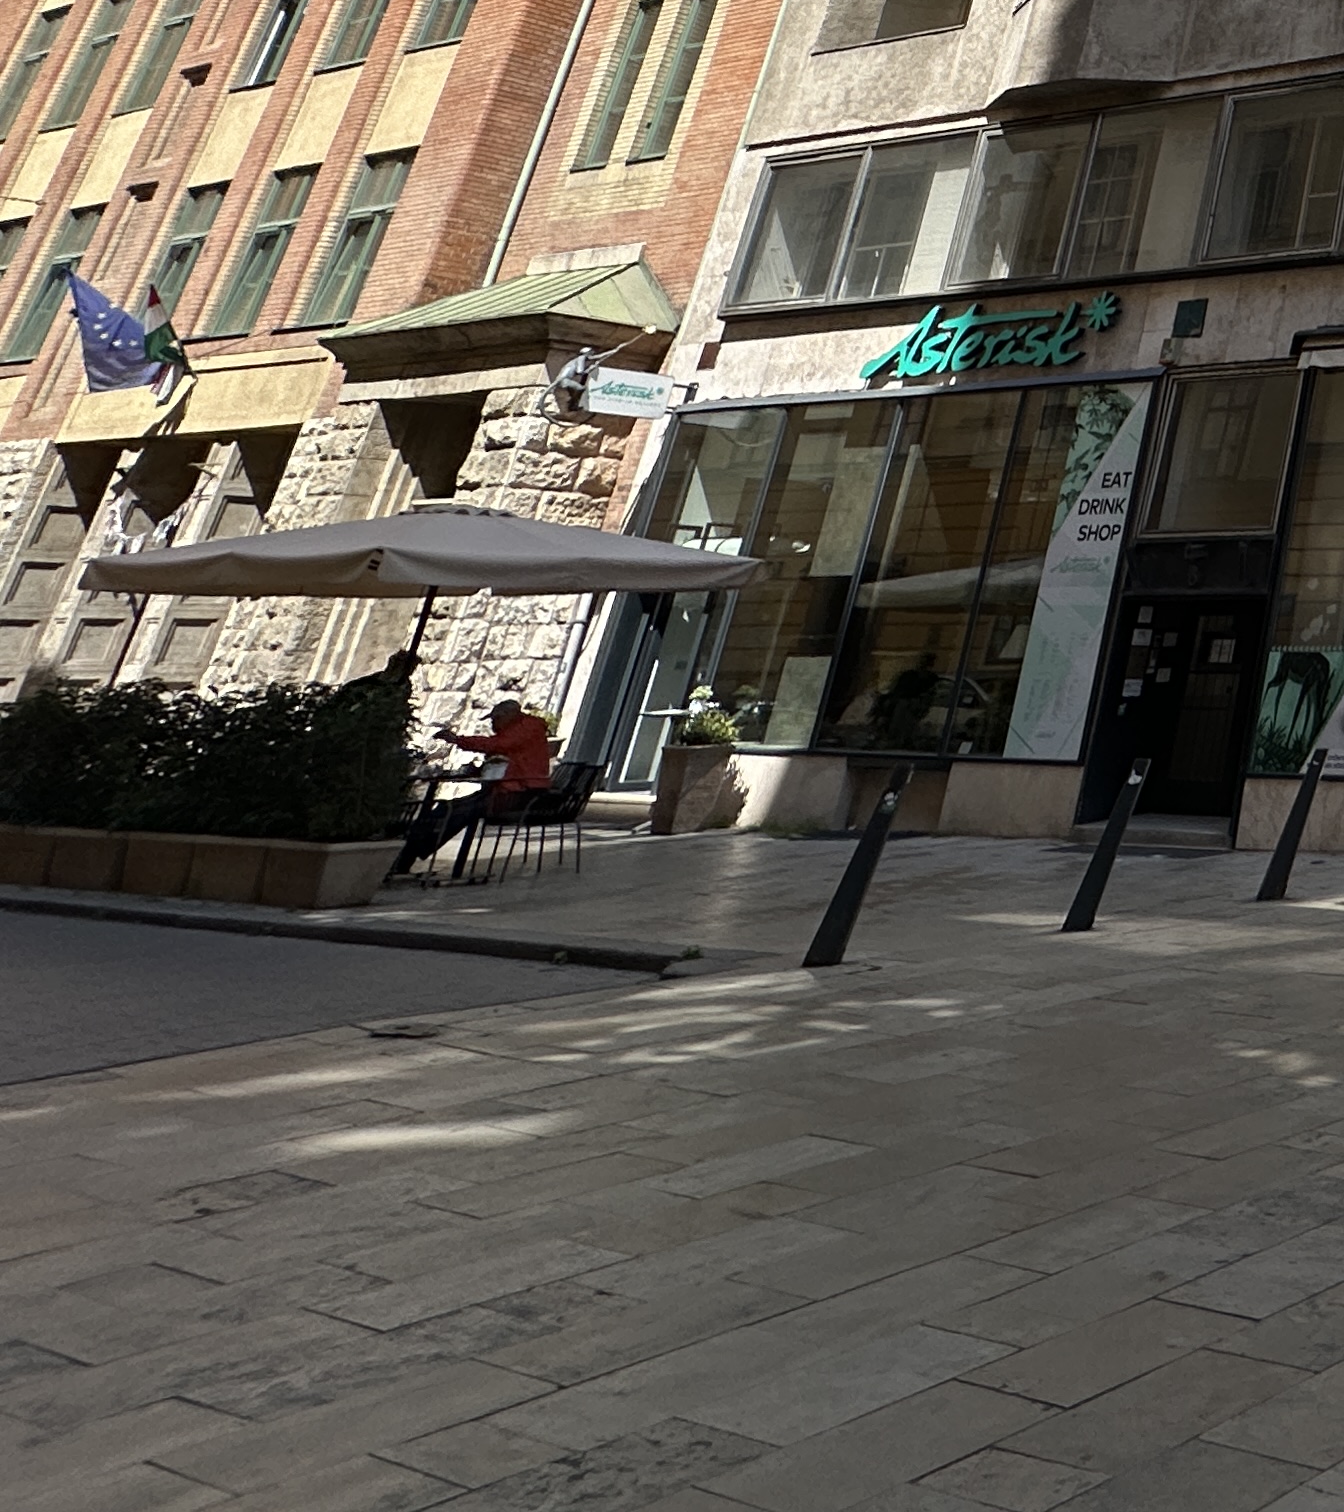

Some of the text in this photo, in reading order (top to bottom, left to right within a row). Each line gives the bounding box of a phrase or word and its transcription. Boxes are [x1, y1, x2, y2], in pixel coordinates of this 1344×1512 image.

[860, 302, 1086, 378] Asterisk
[1101, 471, 1132, 488] EAT
[1078, 498, 1126, 515] DRINK
[1077, 523, 1121, 541] SHOP
